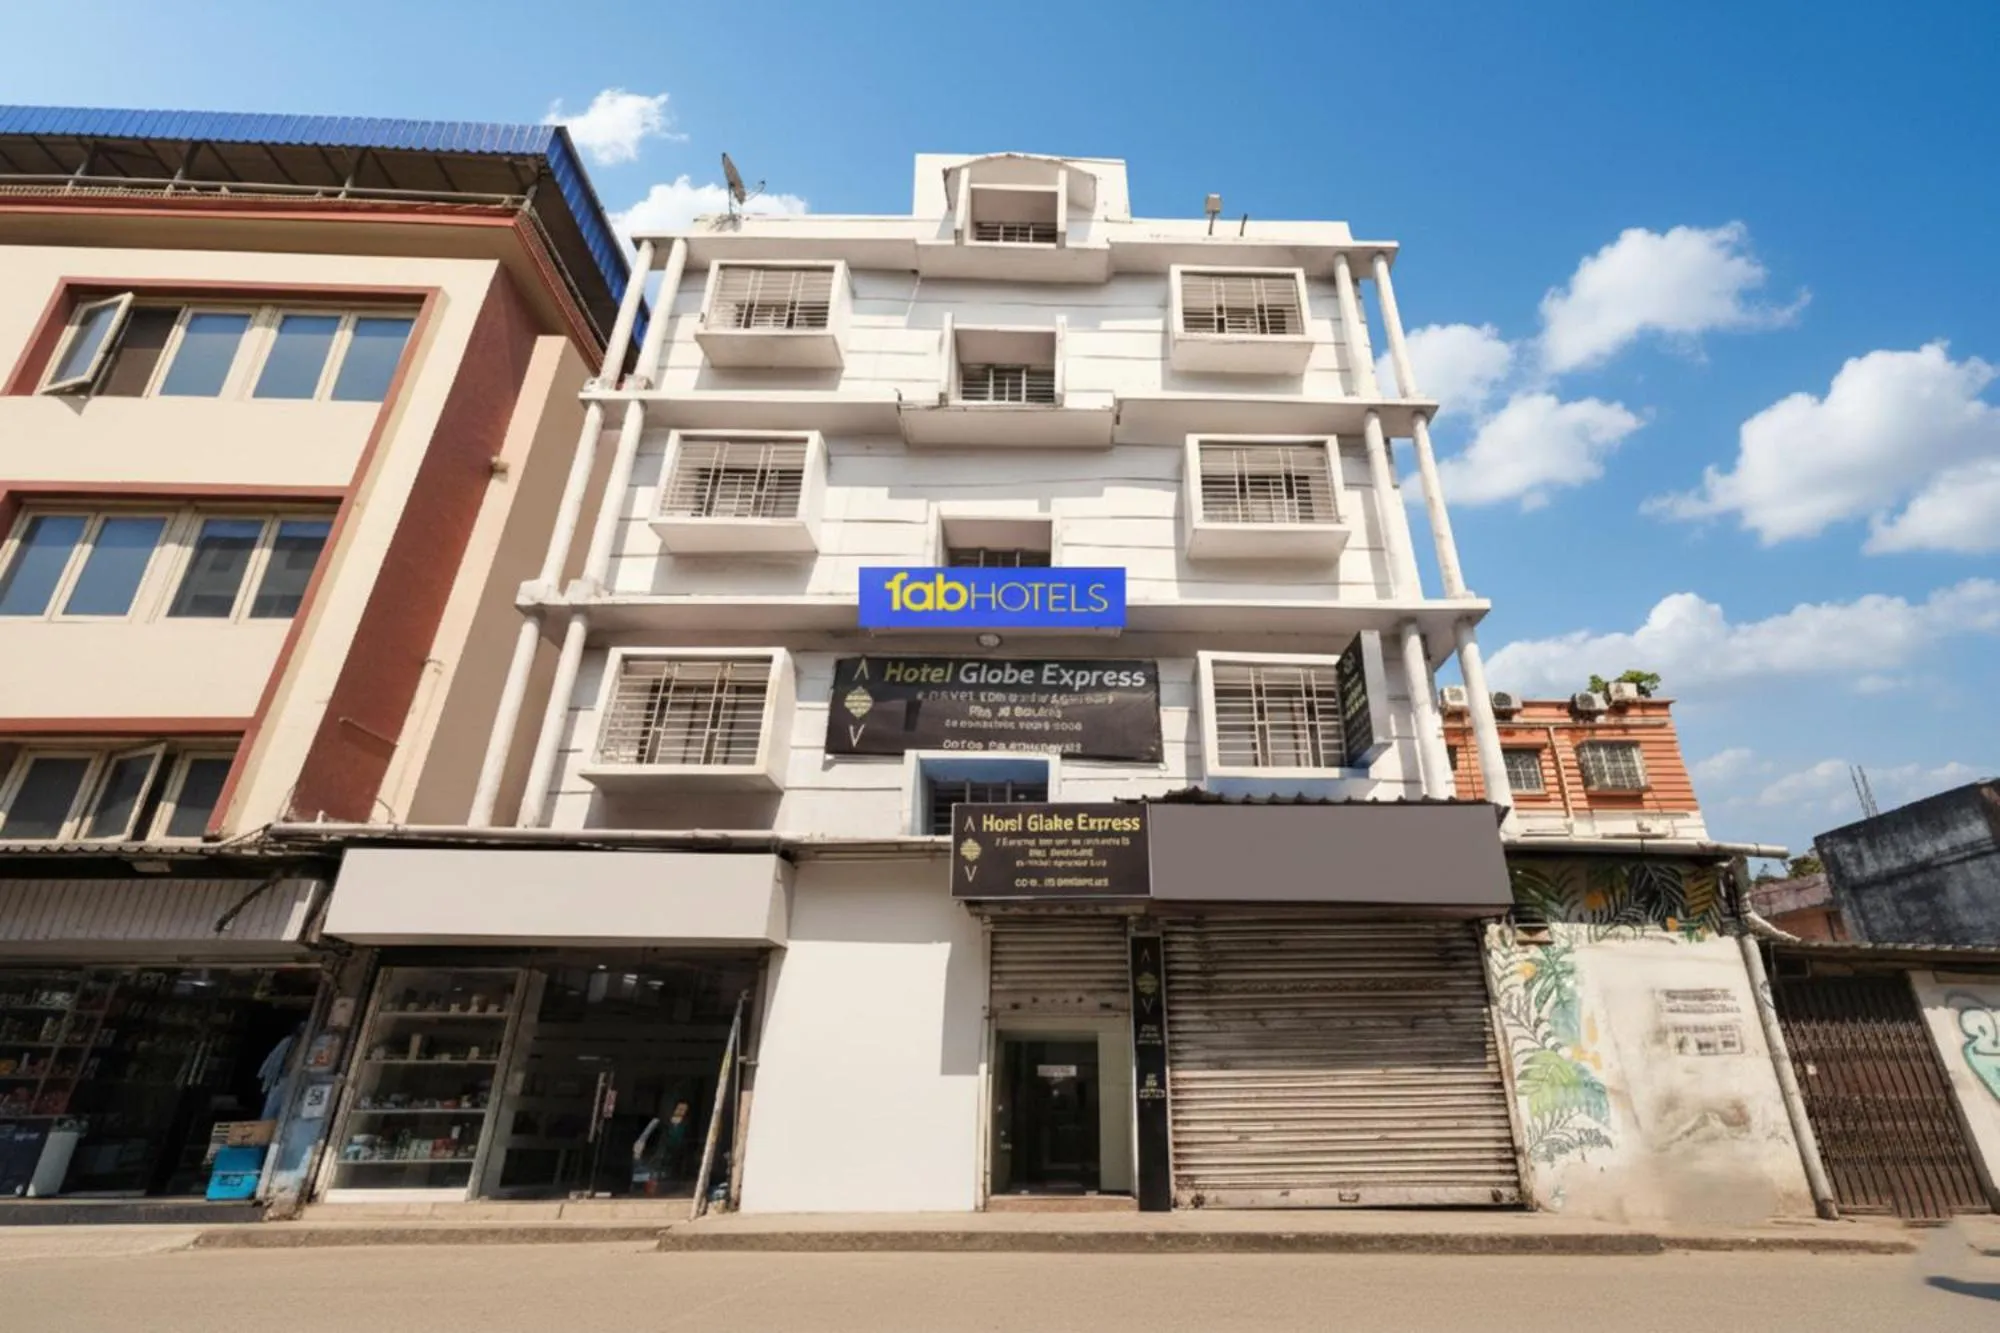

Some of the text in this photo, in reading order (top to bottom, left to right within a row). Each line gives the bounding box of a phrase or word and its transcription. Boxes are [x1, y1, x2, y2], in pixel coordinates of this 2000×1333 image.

[884, 661, 1147, 691] Hotel Globe Express
